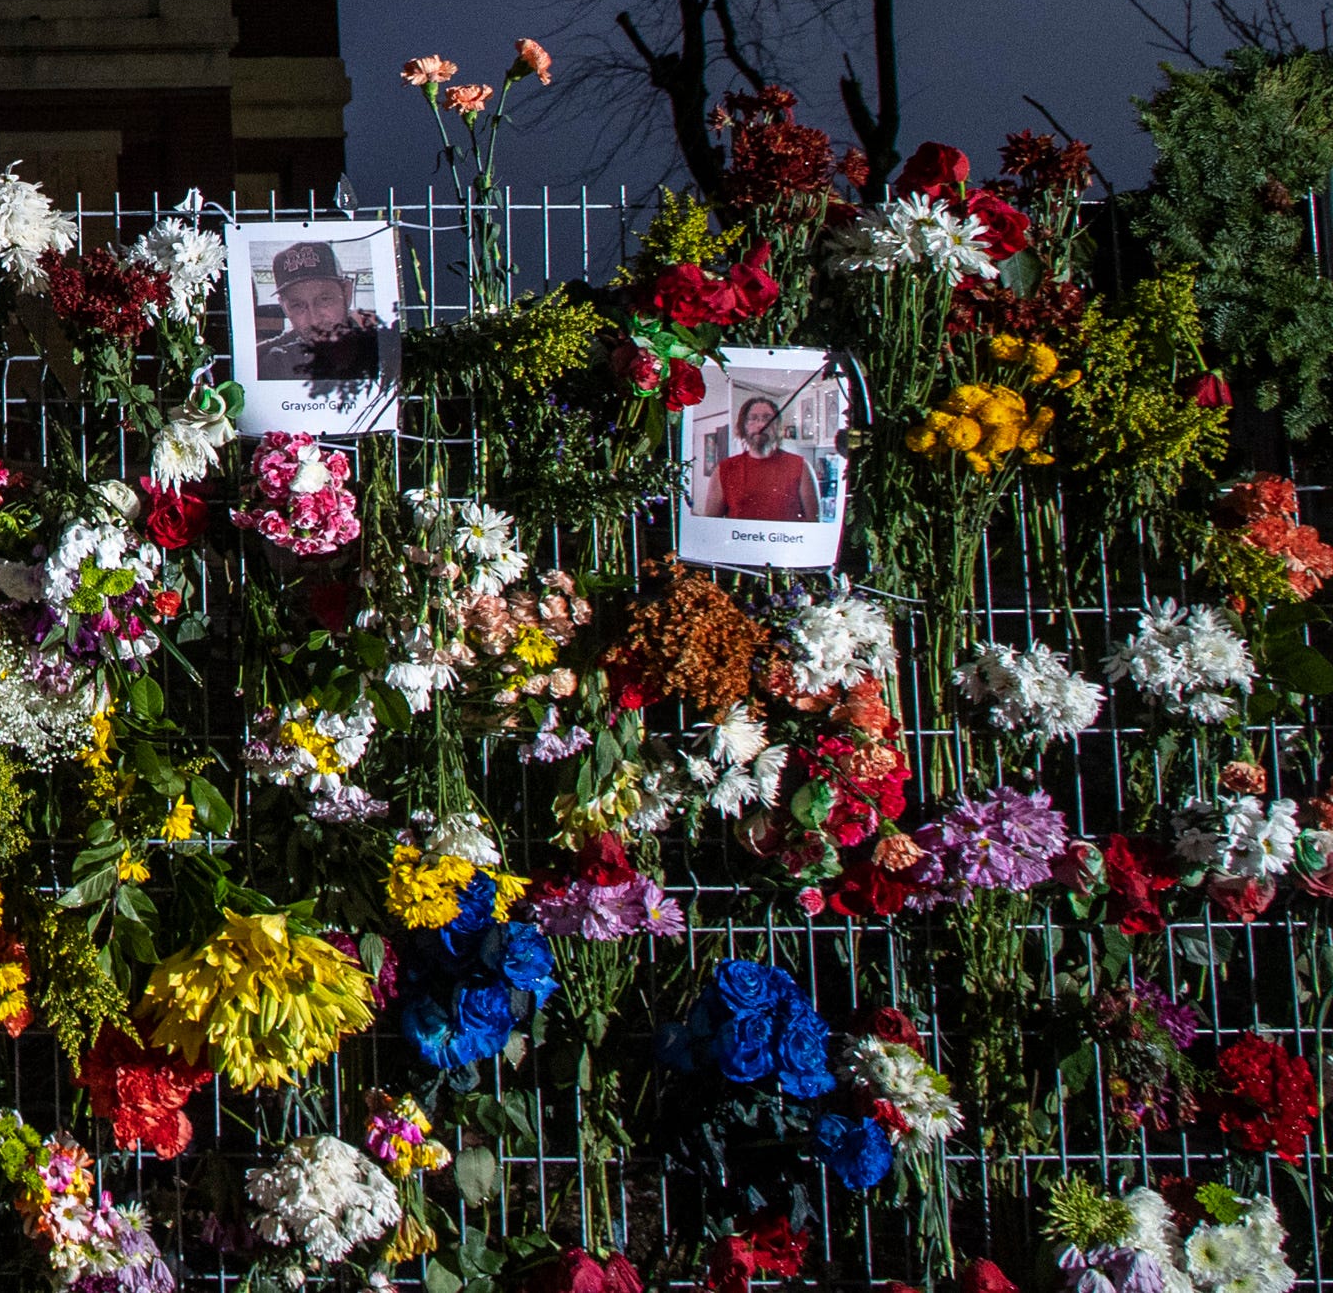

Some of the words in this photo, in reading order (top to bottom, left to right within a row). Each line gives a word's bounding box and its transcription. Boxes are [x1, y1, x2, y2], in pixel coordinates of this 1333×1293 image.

[281, 400, 325, 413] Grayson
[731, 530, 766, 542] Derek
[768, 532, 804, 544] Gilbert
